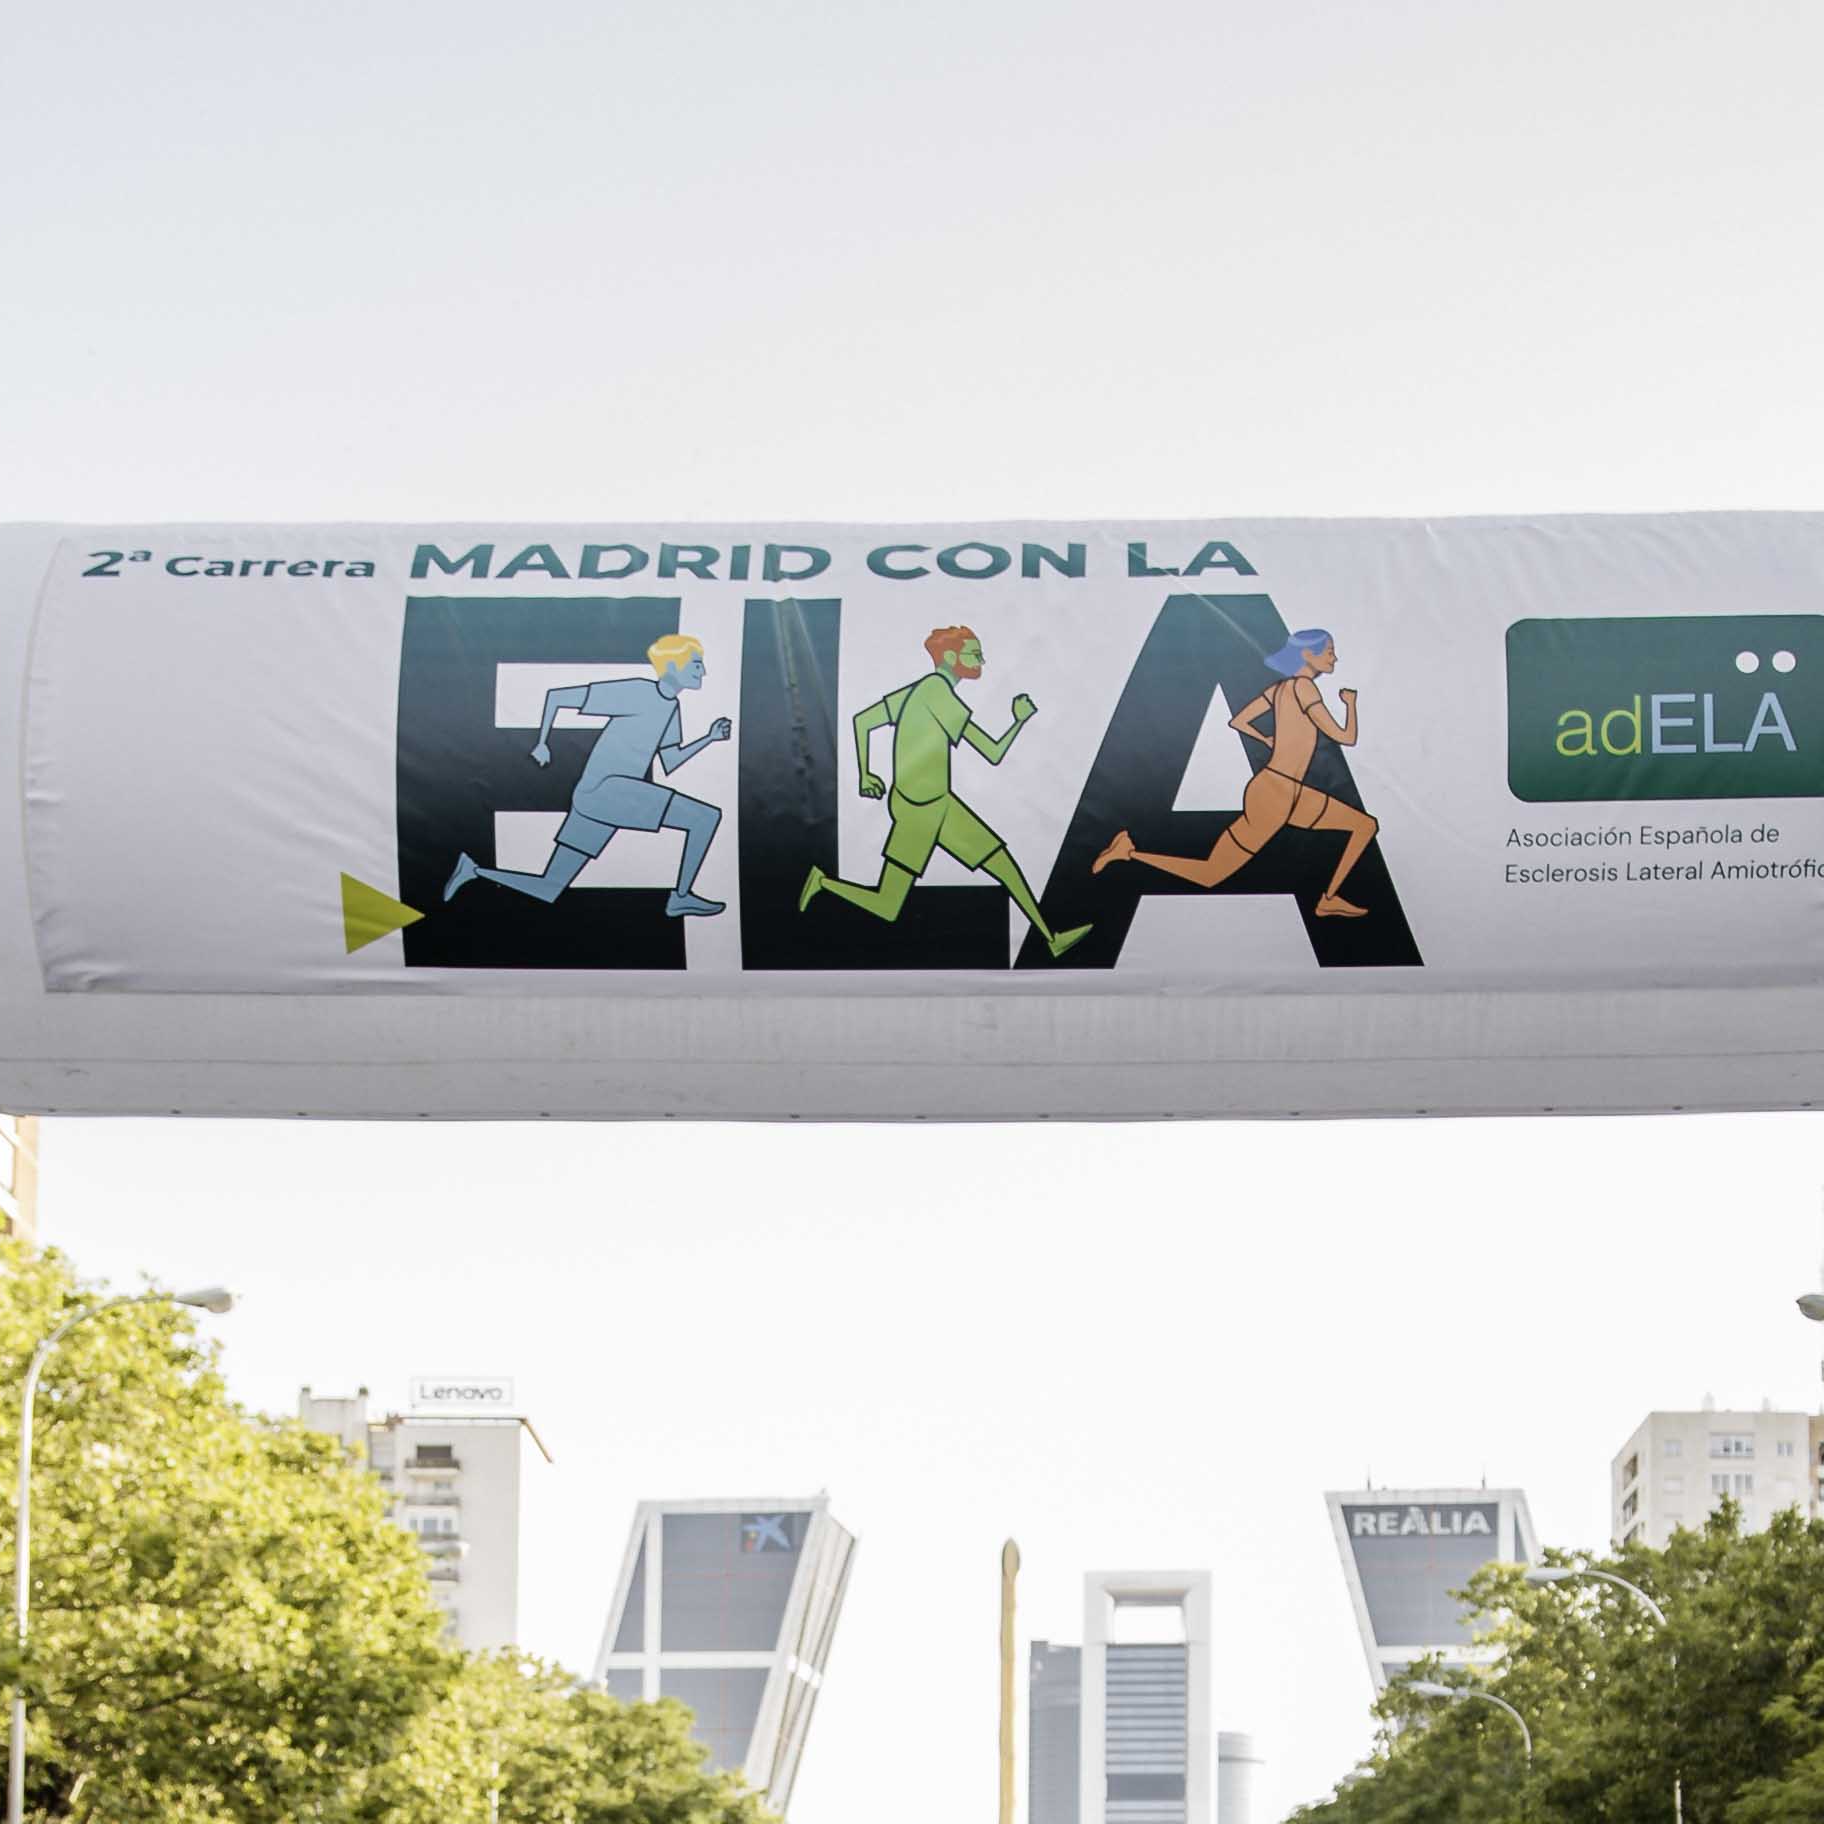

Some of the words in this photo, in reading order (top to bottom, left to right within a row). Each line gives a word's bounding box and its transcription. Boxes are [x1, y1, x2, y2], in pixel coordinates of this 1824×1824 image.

[165, 555, 376, 578] Carrera
[410, 541, 832, 581] MADRID
[866, 541, 1088, 580] CON
[1127, 541, 1260, 578] LA
[396, 593, 1425, 971] ELA
[1505, 826, 1632, 848] Asociación
[1639, 823, 1743, 850] Española
[1751, 824, 1780, 843] de
[1504, 862, 1619, 884] Esclerosis
[1626, 861, 1704, 882] Lateral
[419, 1384, 504, 1401] Lenovo
[1352, 1506, 1492, 1536] REALIA
